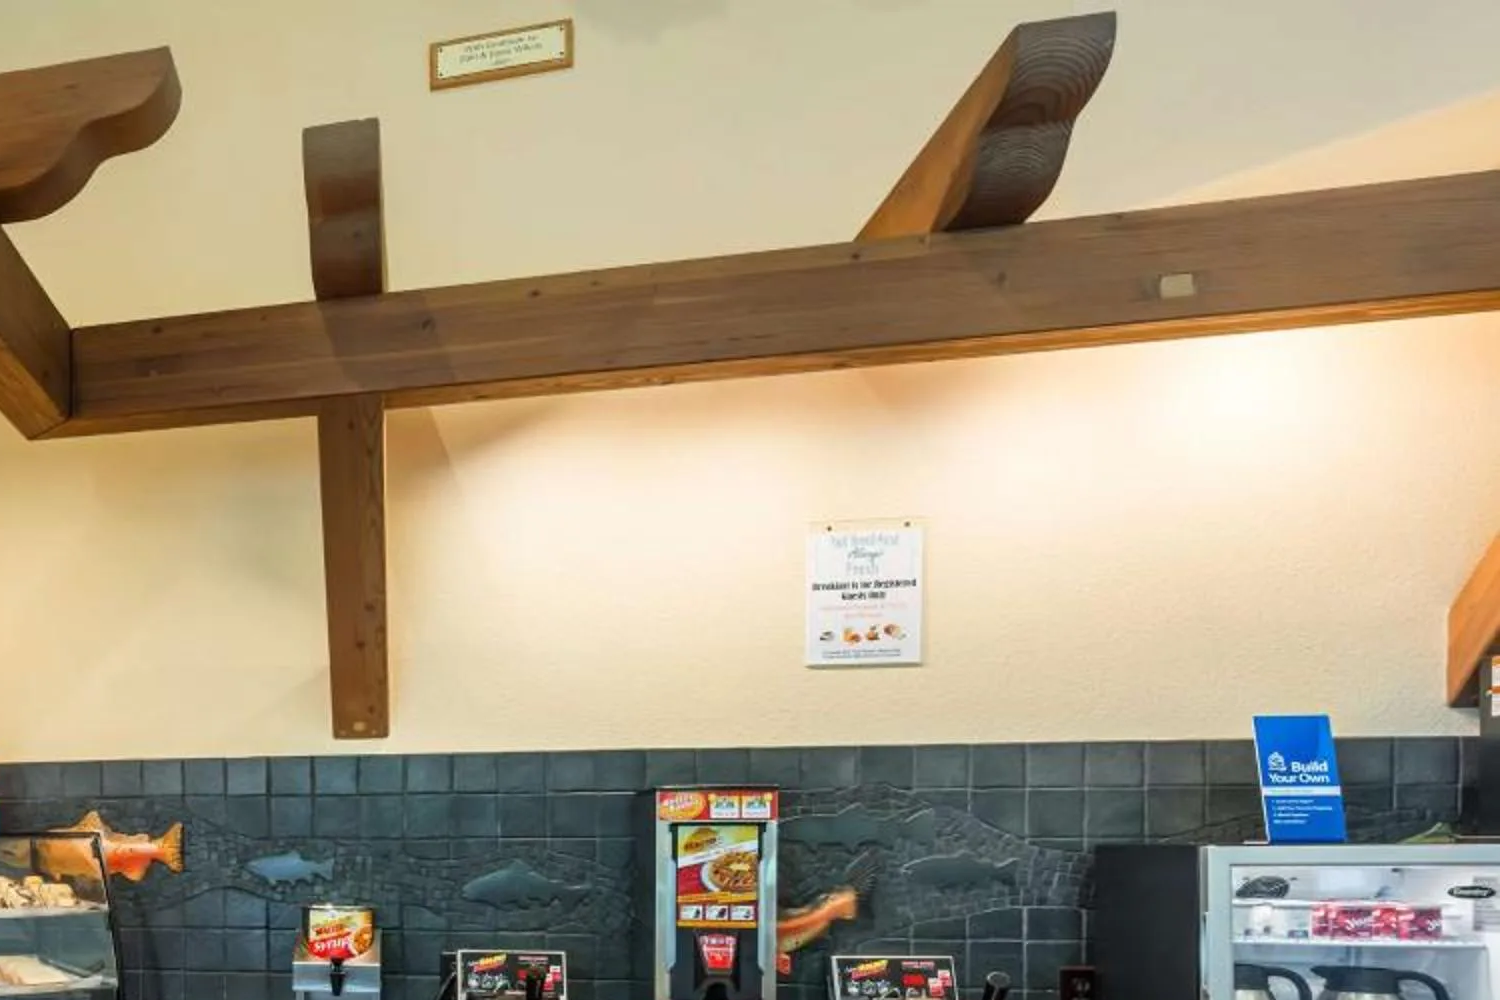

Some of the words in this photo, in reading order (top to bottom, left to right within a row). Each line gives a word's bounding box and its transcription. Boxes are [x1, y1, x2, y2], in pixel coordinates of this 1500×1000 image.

[1291, 761, 1329, 773] Build
[1269, 773, 1297, 784] Your
[1299, 773, 1330, 784] Own
